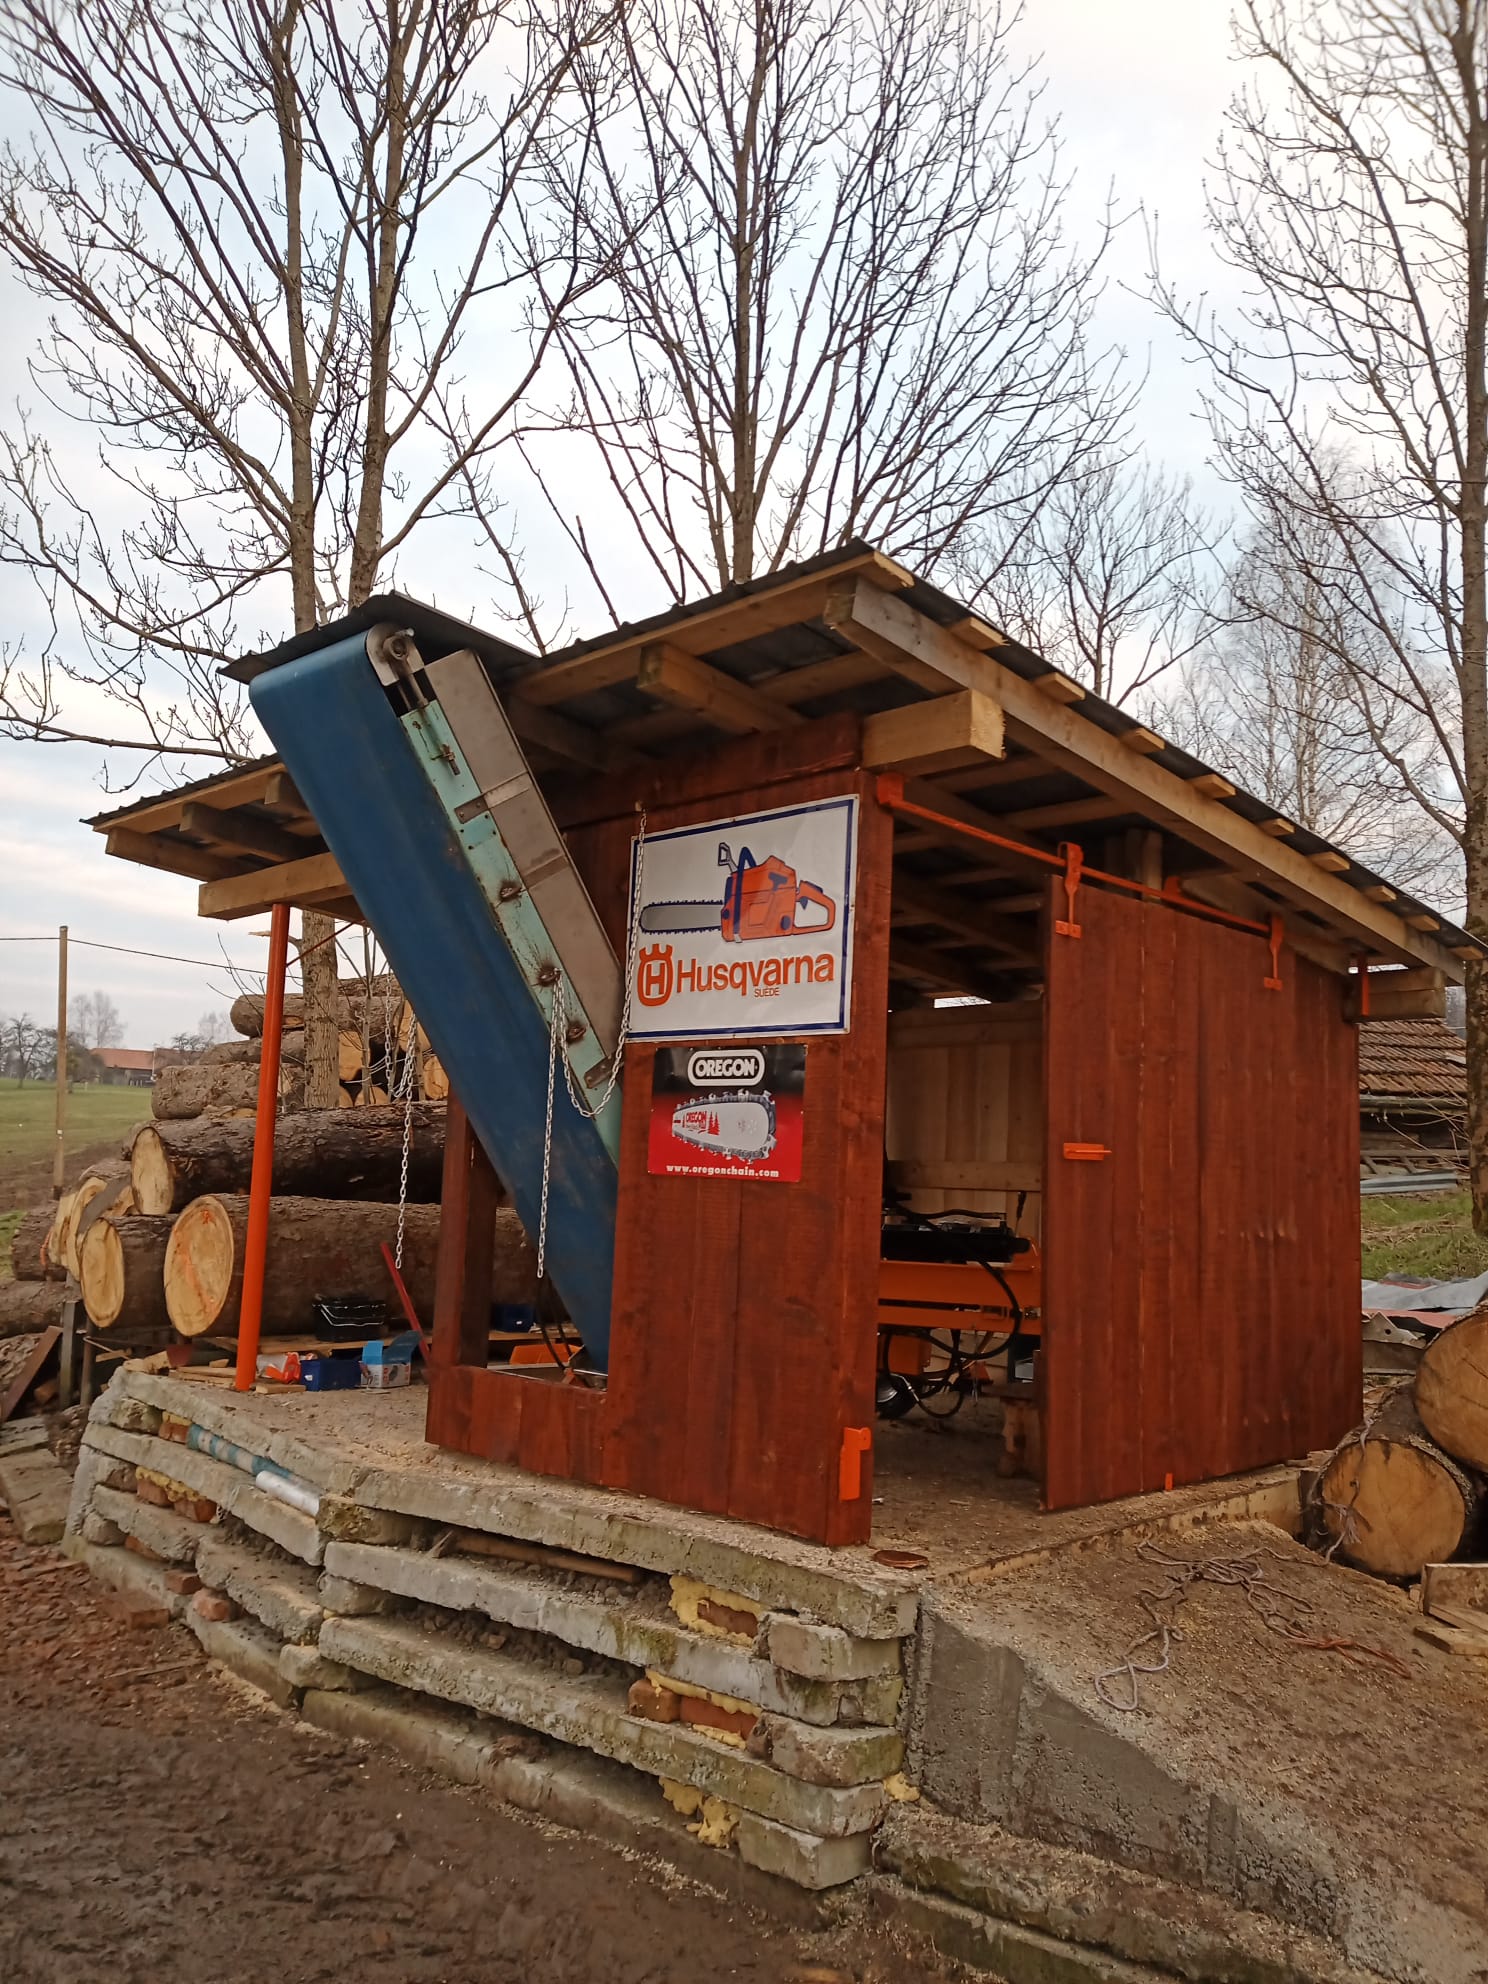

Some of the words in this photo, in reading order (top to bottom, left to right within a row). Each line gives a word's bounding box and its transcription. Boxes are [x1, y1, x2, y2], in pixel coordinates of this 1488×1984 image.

[676, 953, 834, 997] Husqvarna
[695, 1058, 756, 1077] OREGON
[666, 1165, 779, 1178] www.oregonchain.com
